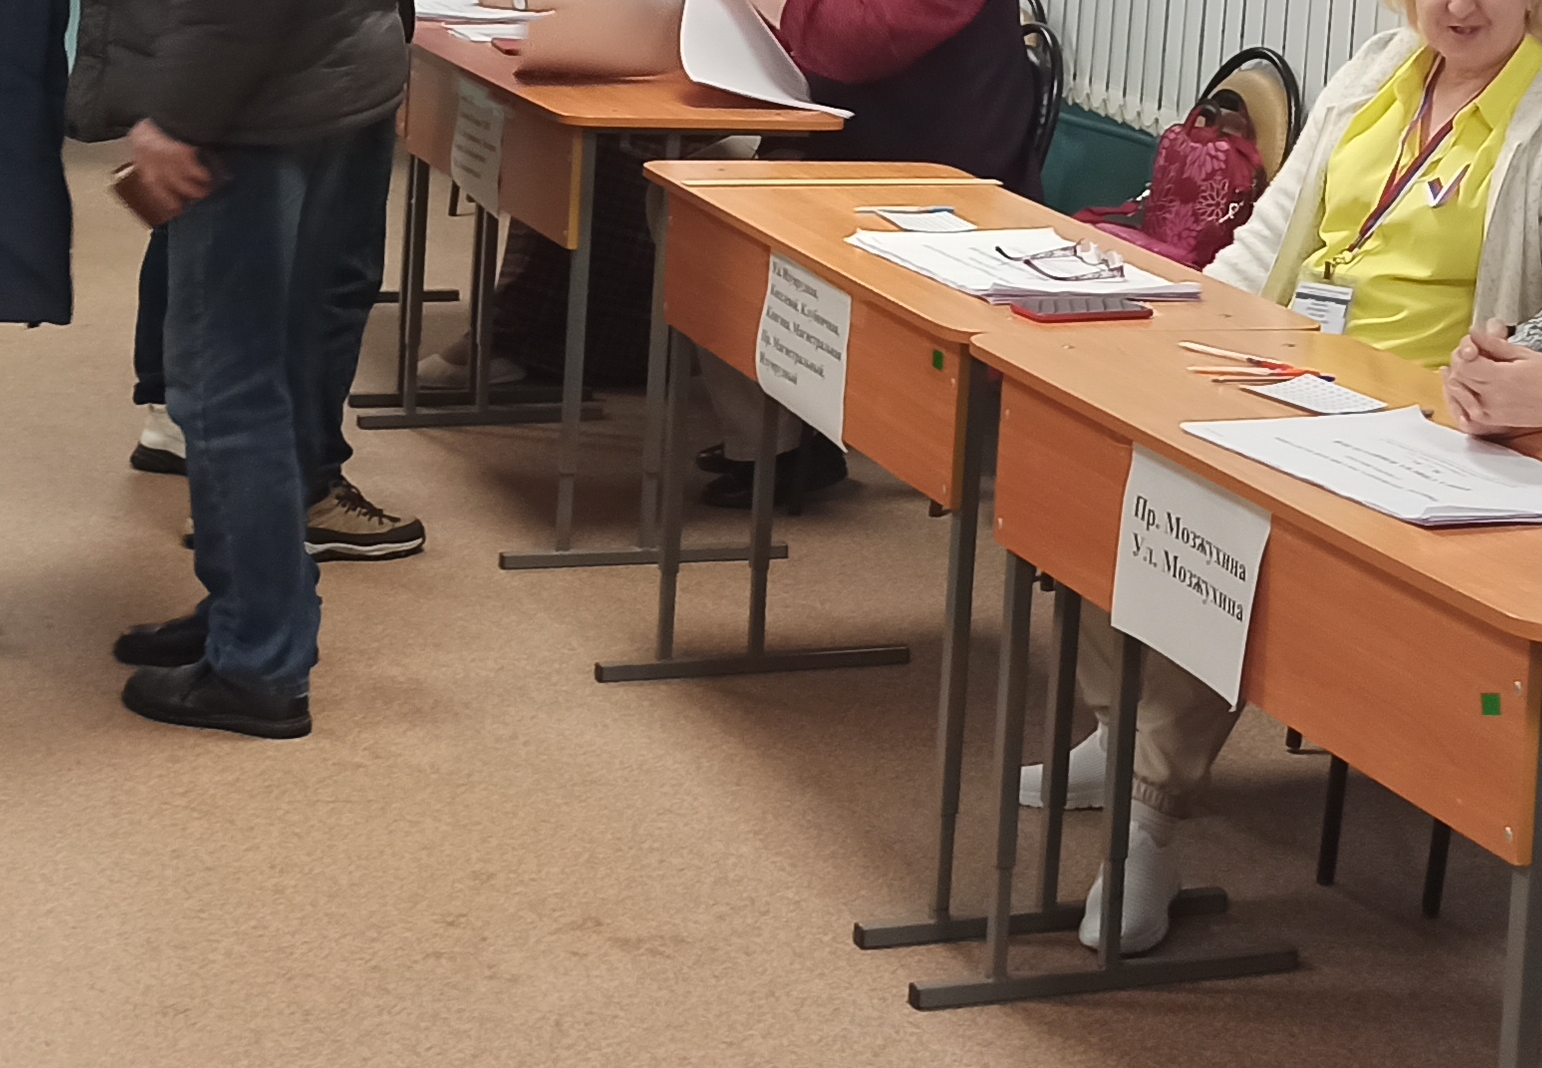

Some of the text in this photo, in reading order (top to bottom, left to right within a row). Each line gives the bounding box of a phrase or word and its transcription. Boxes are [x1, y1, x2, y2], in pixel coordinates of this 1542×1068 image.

[1132, 531, 1243, 623] Ул. Мозжухина
[1134, 495, 1246, 582] Пр. Мозжухина
